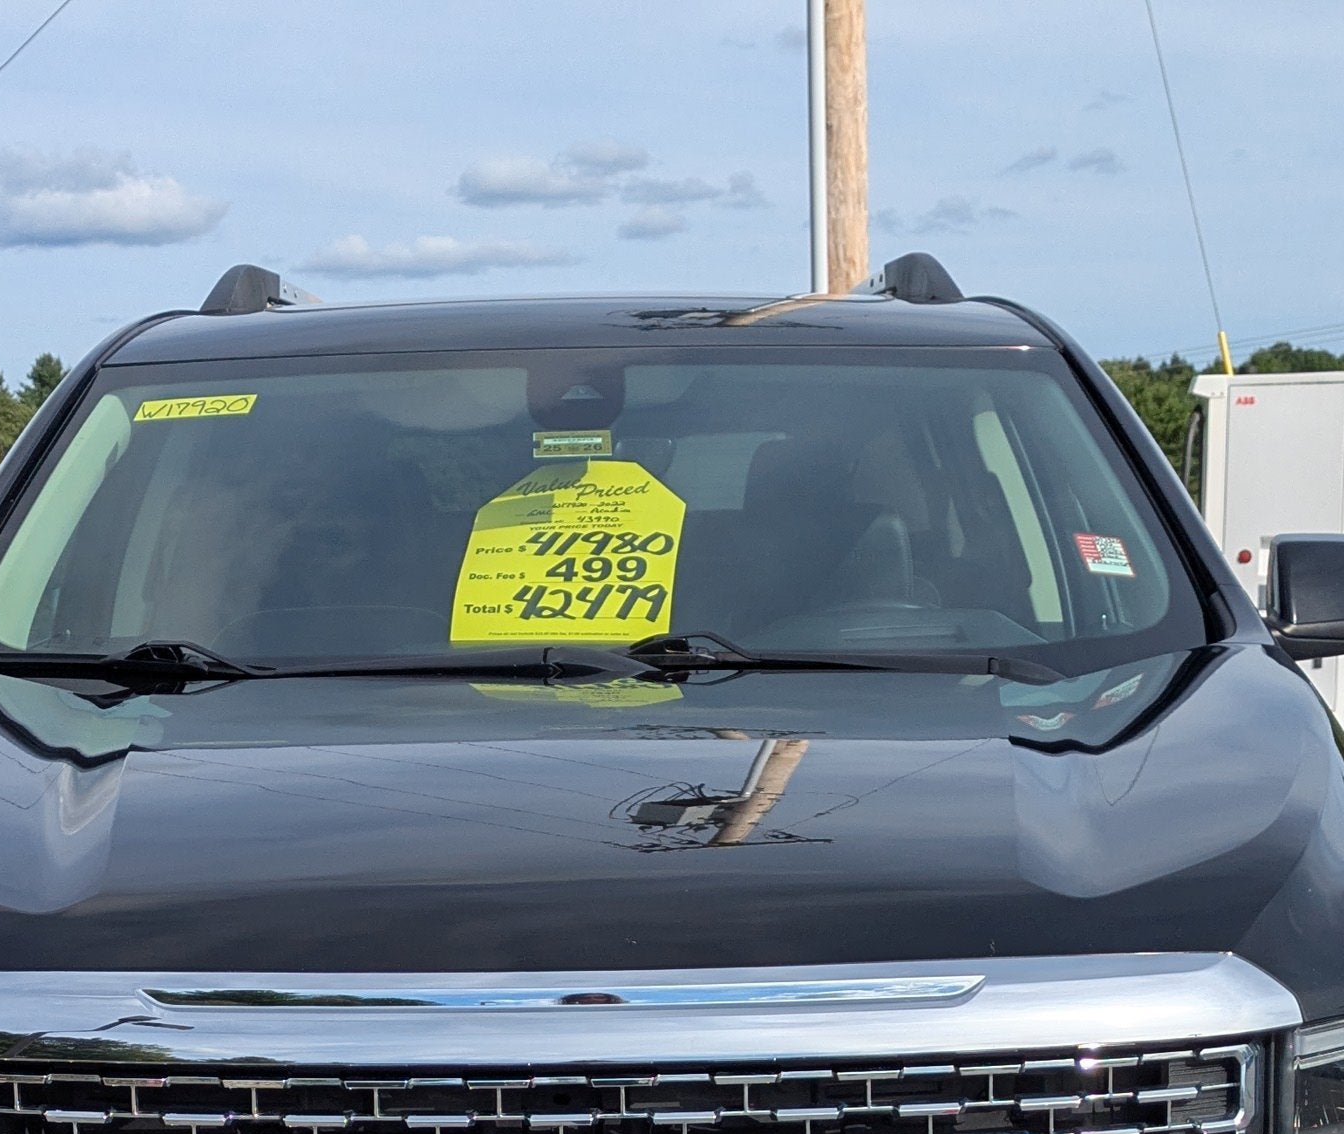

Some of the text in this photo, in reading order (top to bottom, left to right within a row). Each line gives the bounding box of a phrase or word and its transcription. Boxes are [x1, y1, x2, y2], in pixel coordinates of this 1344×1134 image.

[141, 397, 250, 419] W17920
[543, 444, 562, 452] 25
[583, 443, 603, 451] 26
[575, 481, 650, 501] Priced
[475, 531, 674, 556] Price $ 41980
[468, 572, 493, 580] Doc.
[495, 572, 516, 580] Fee
[545, 556, 648, 582] 499
[464, 584, 669, 623] Total $ 42479
